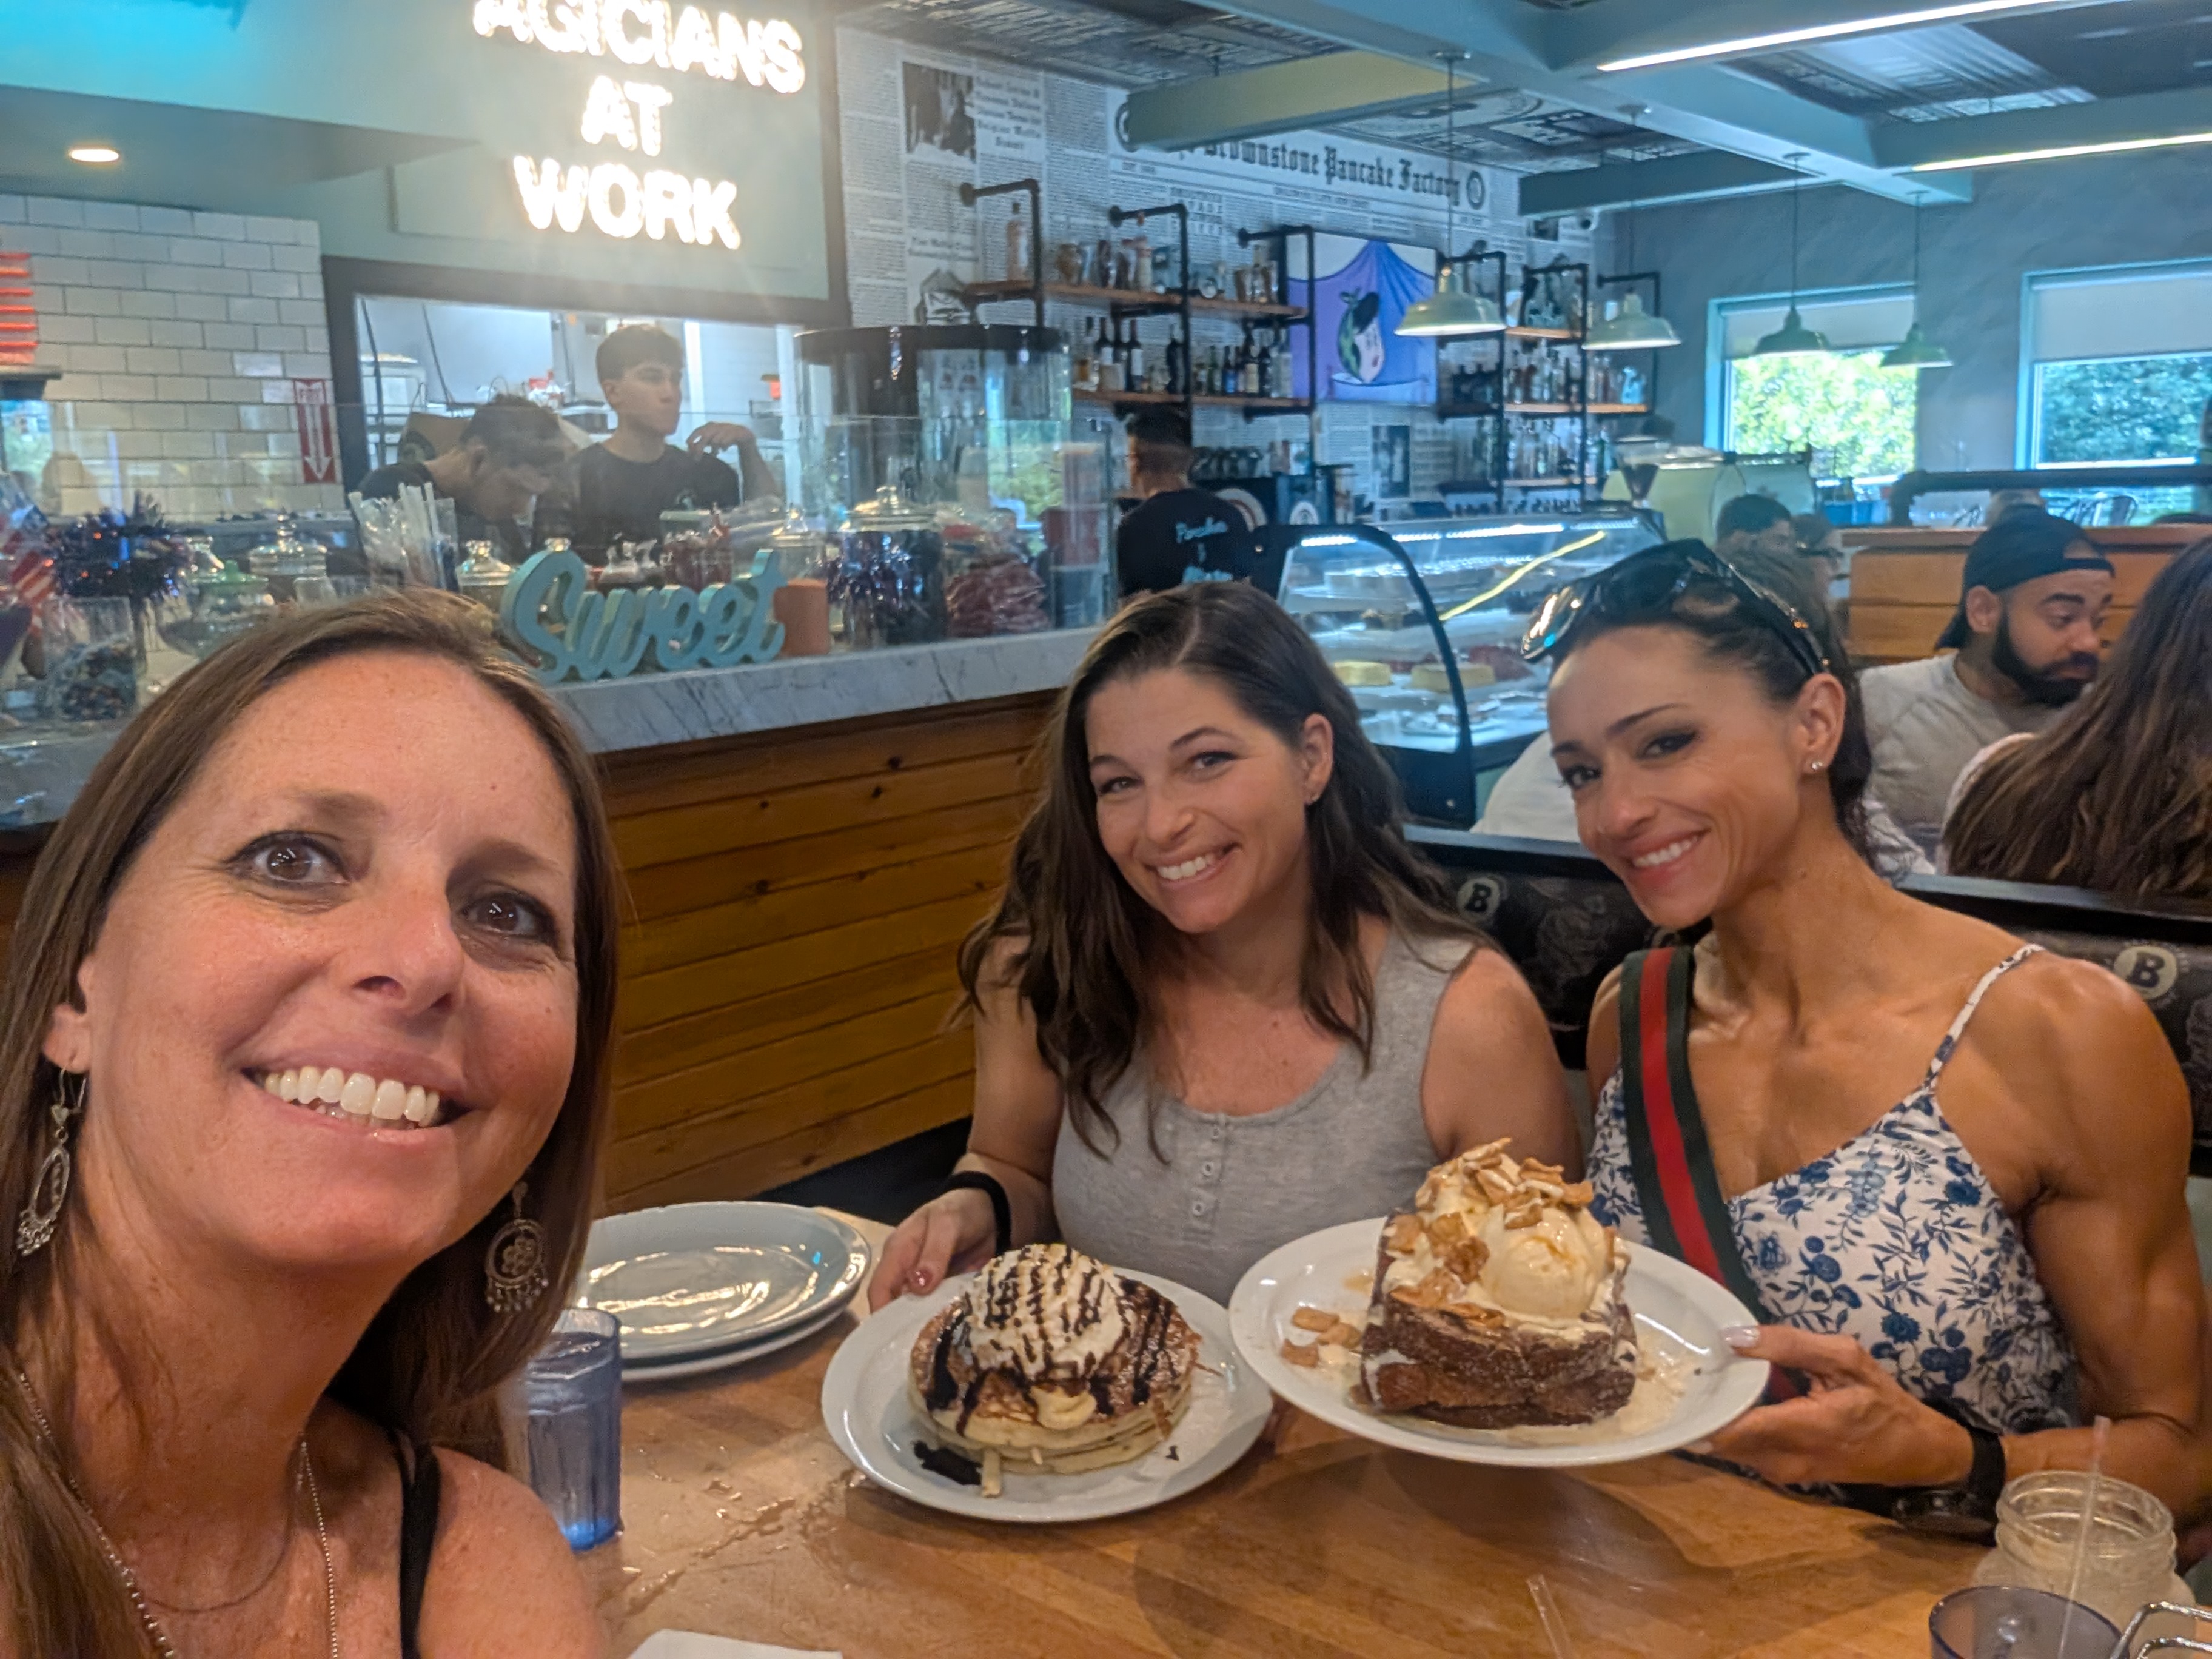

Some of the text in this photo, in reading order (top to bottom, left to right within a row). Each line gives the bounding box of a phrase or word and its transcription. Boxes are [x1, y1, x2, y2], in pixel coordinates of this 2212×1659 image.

[581, 75, 673, 156] AT
[513, 155, 740, 250] WORK
[1324, 146, 1393, 187] Pancake
[1398, 158, 1460, 206] Factory
[500, 548, 788, 684] Sweet
[2126, 952, 2165, 987] B
